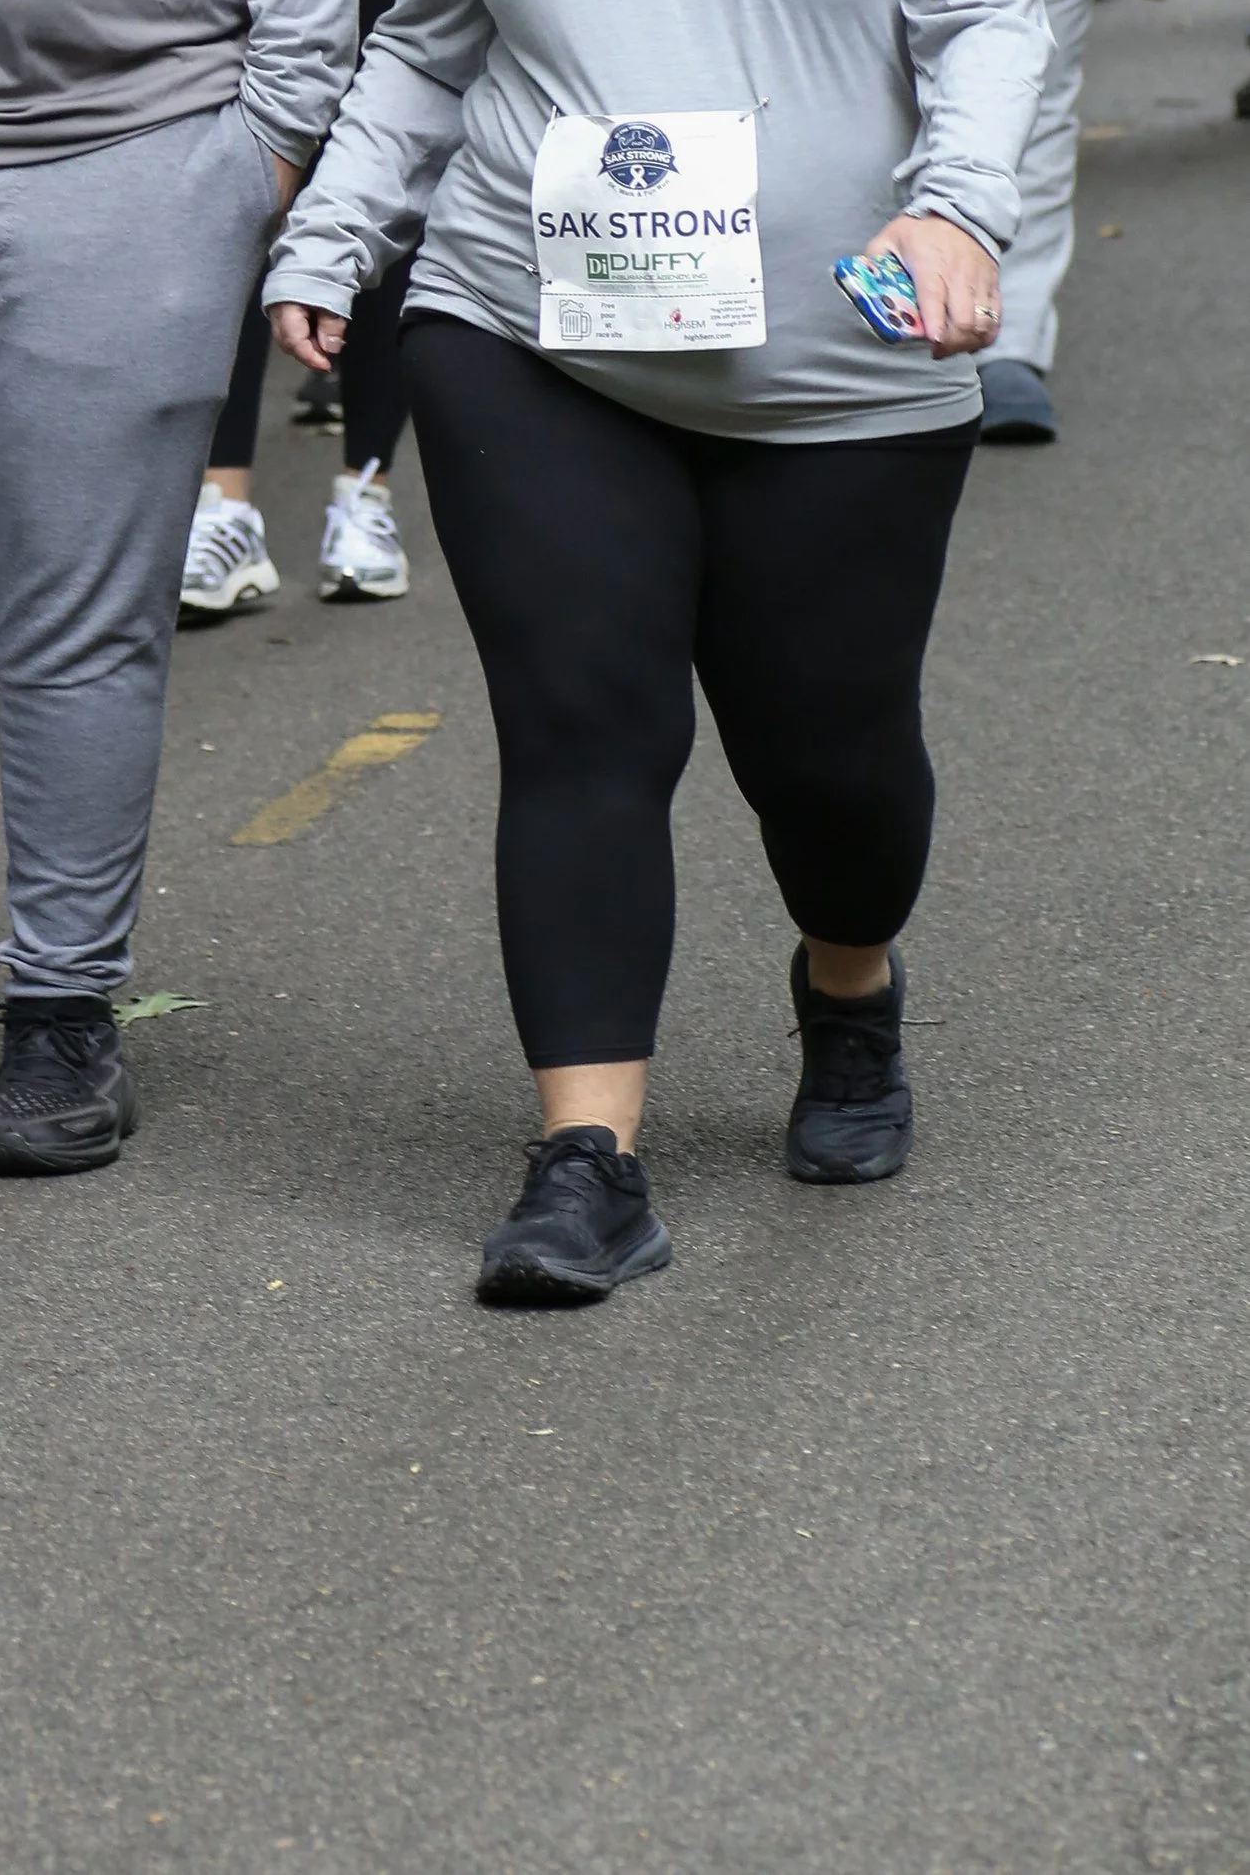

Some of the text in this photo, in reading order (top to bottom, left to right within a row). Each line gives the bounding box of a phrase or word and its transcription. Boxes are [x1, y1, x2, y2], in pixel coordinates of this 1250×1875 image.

[604, 150, 671, 165] SAK STRONG
[538, 207, 751, 239] SAK STRONG
[610, 251, 706, 271] DUFFY
